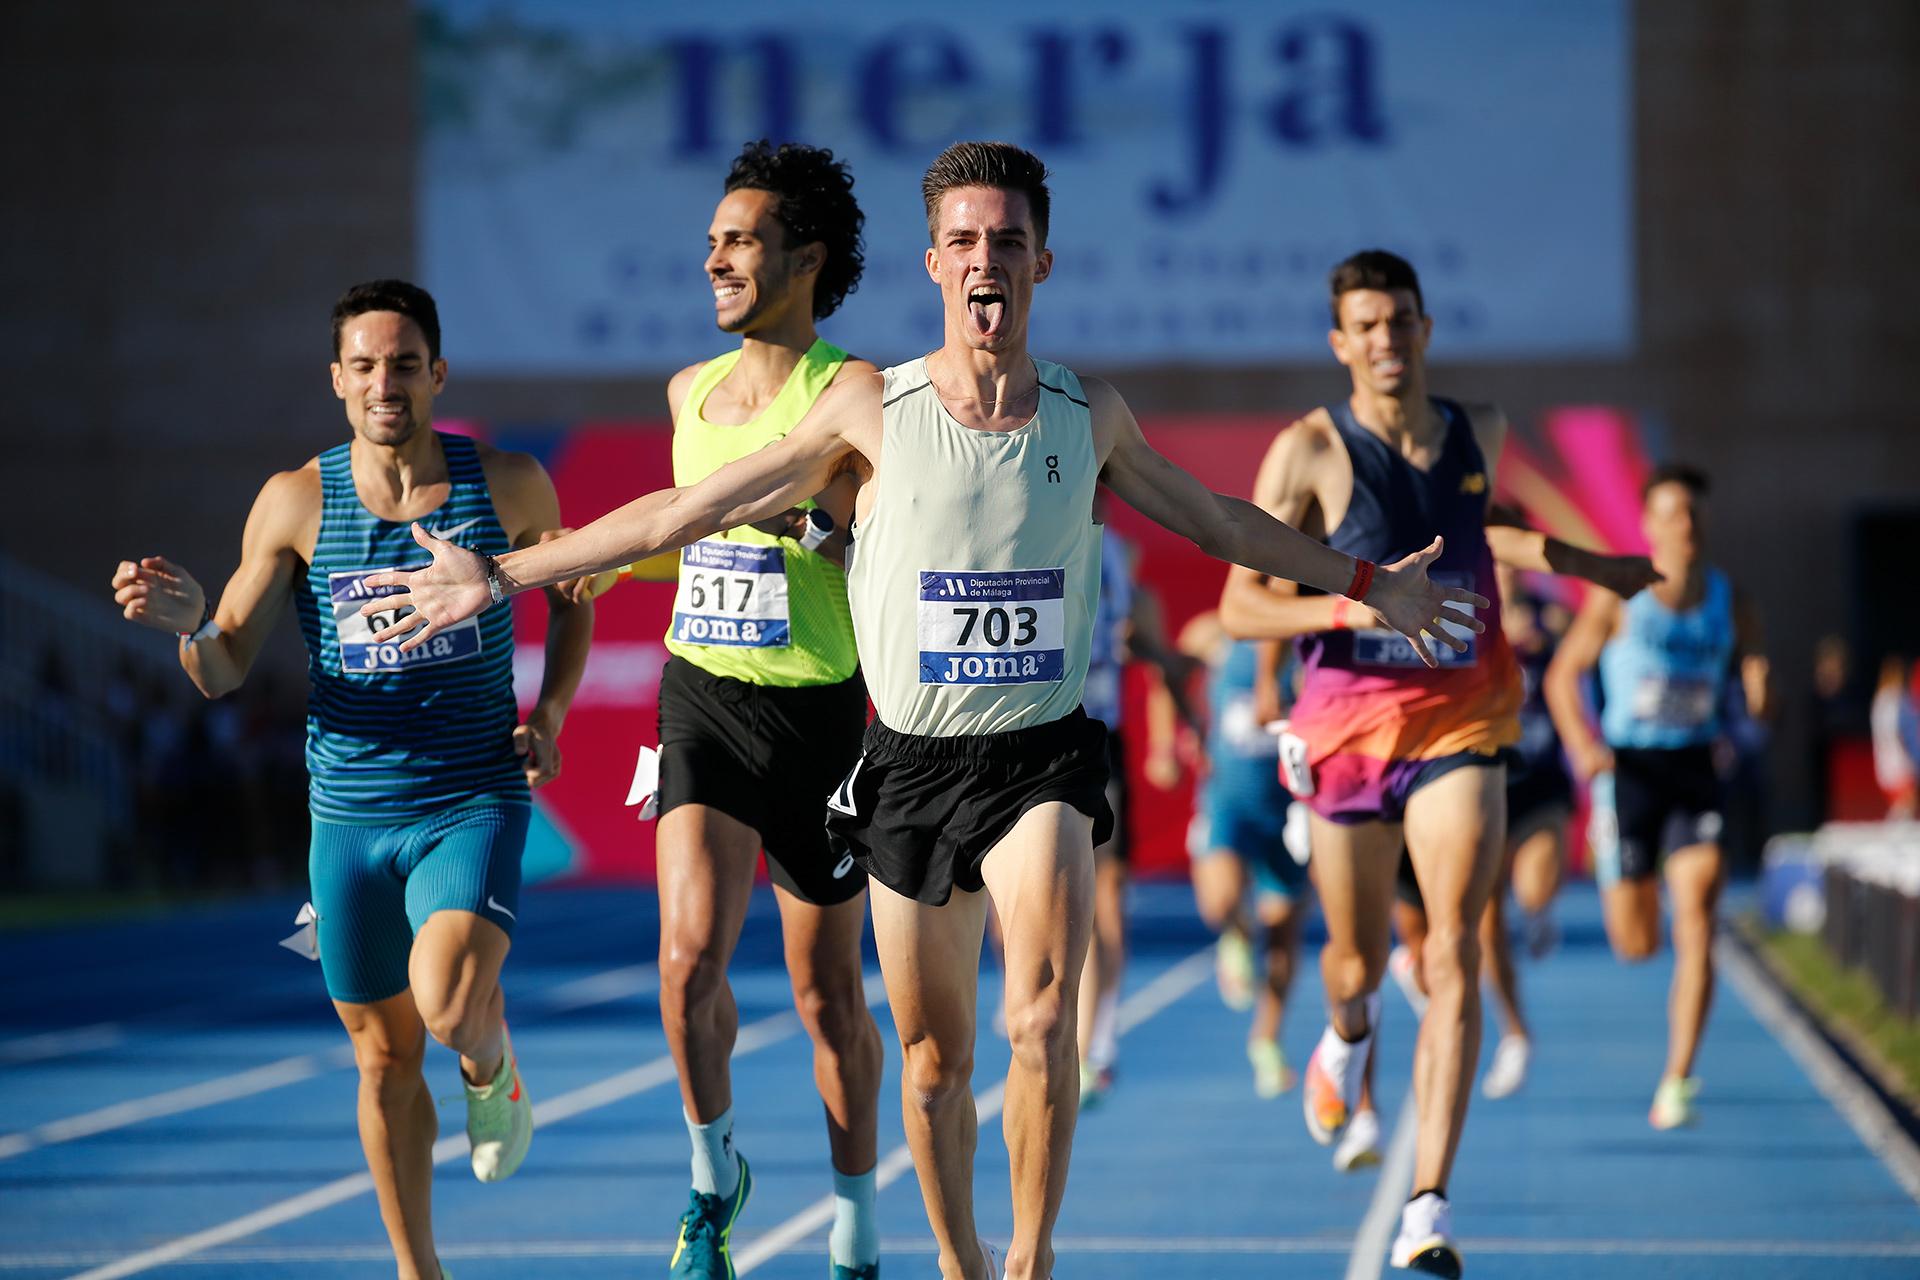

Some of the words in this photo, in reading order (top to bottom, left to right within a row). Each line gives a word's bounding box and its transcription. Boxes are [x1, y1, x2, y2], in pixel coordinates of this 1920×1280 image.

[666, 8, 1390, 220] nerja
[691, 573, 755, 613] 617
[969, 578, 1013, 589] Diputación
[1015, 576, 1050, 586] Provincial
[969, 589, 981, 597] de
[982, 588, 1012, 598] Málaga
[952, 606, 1038, 647] 703
